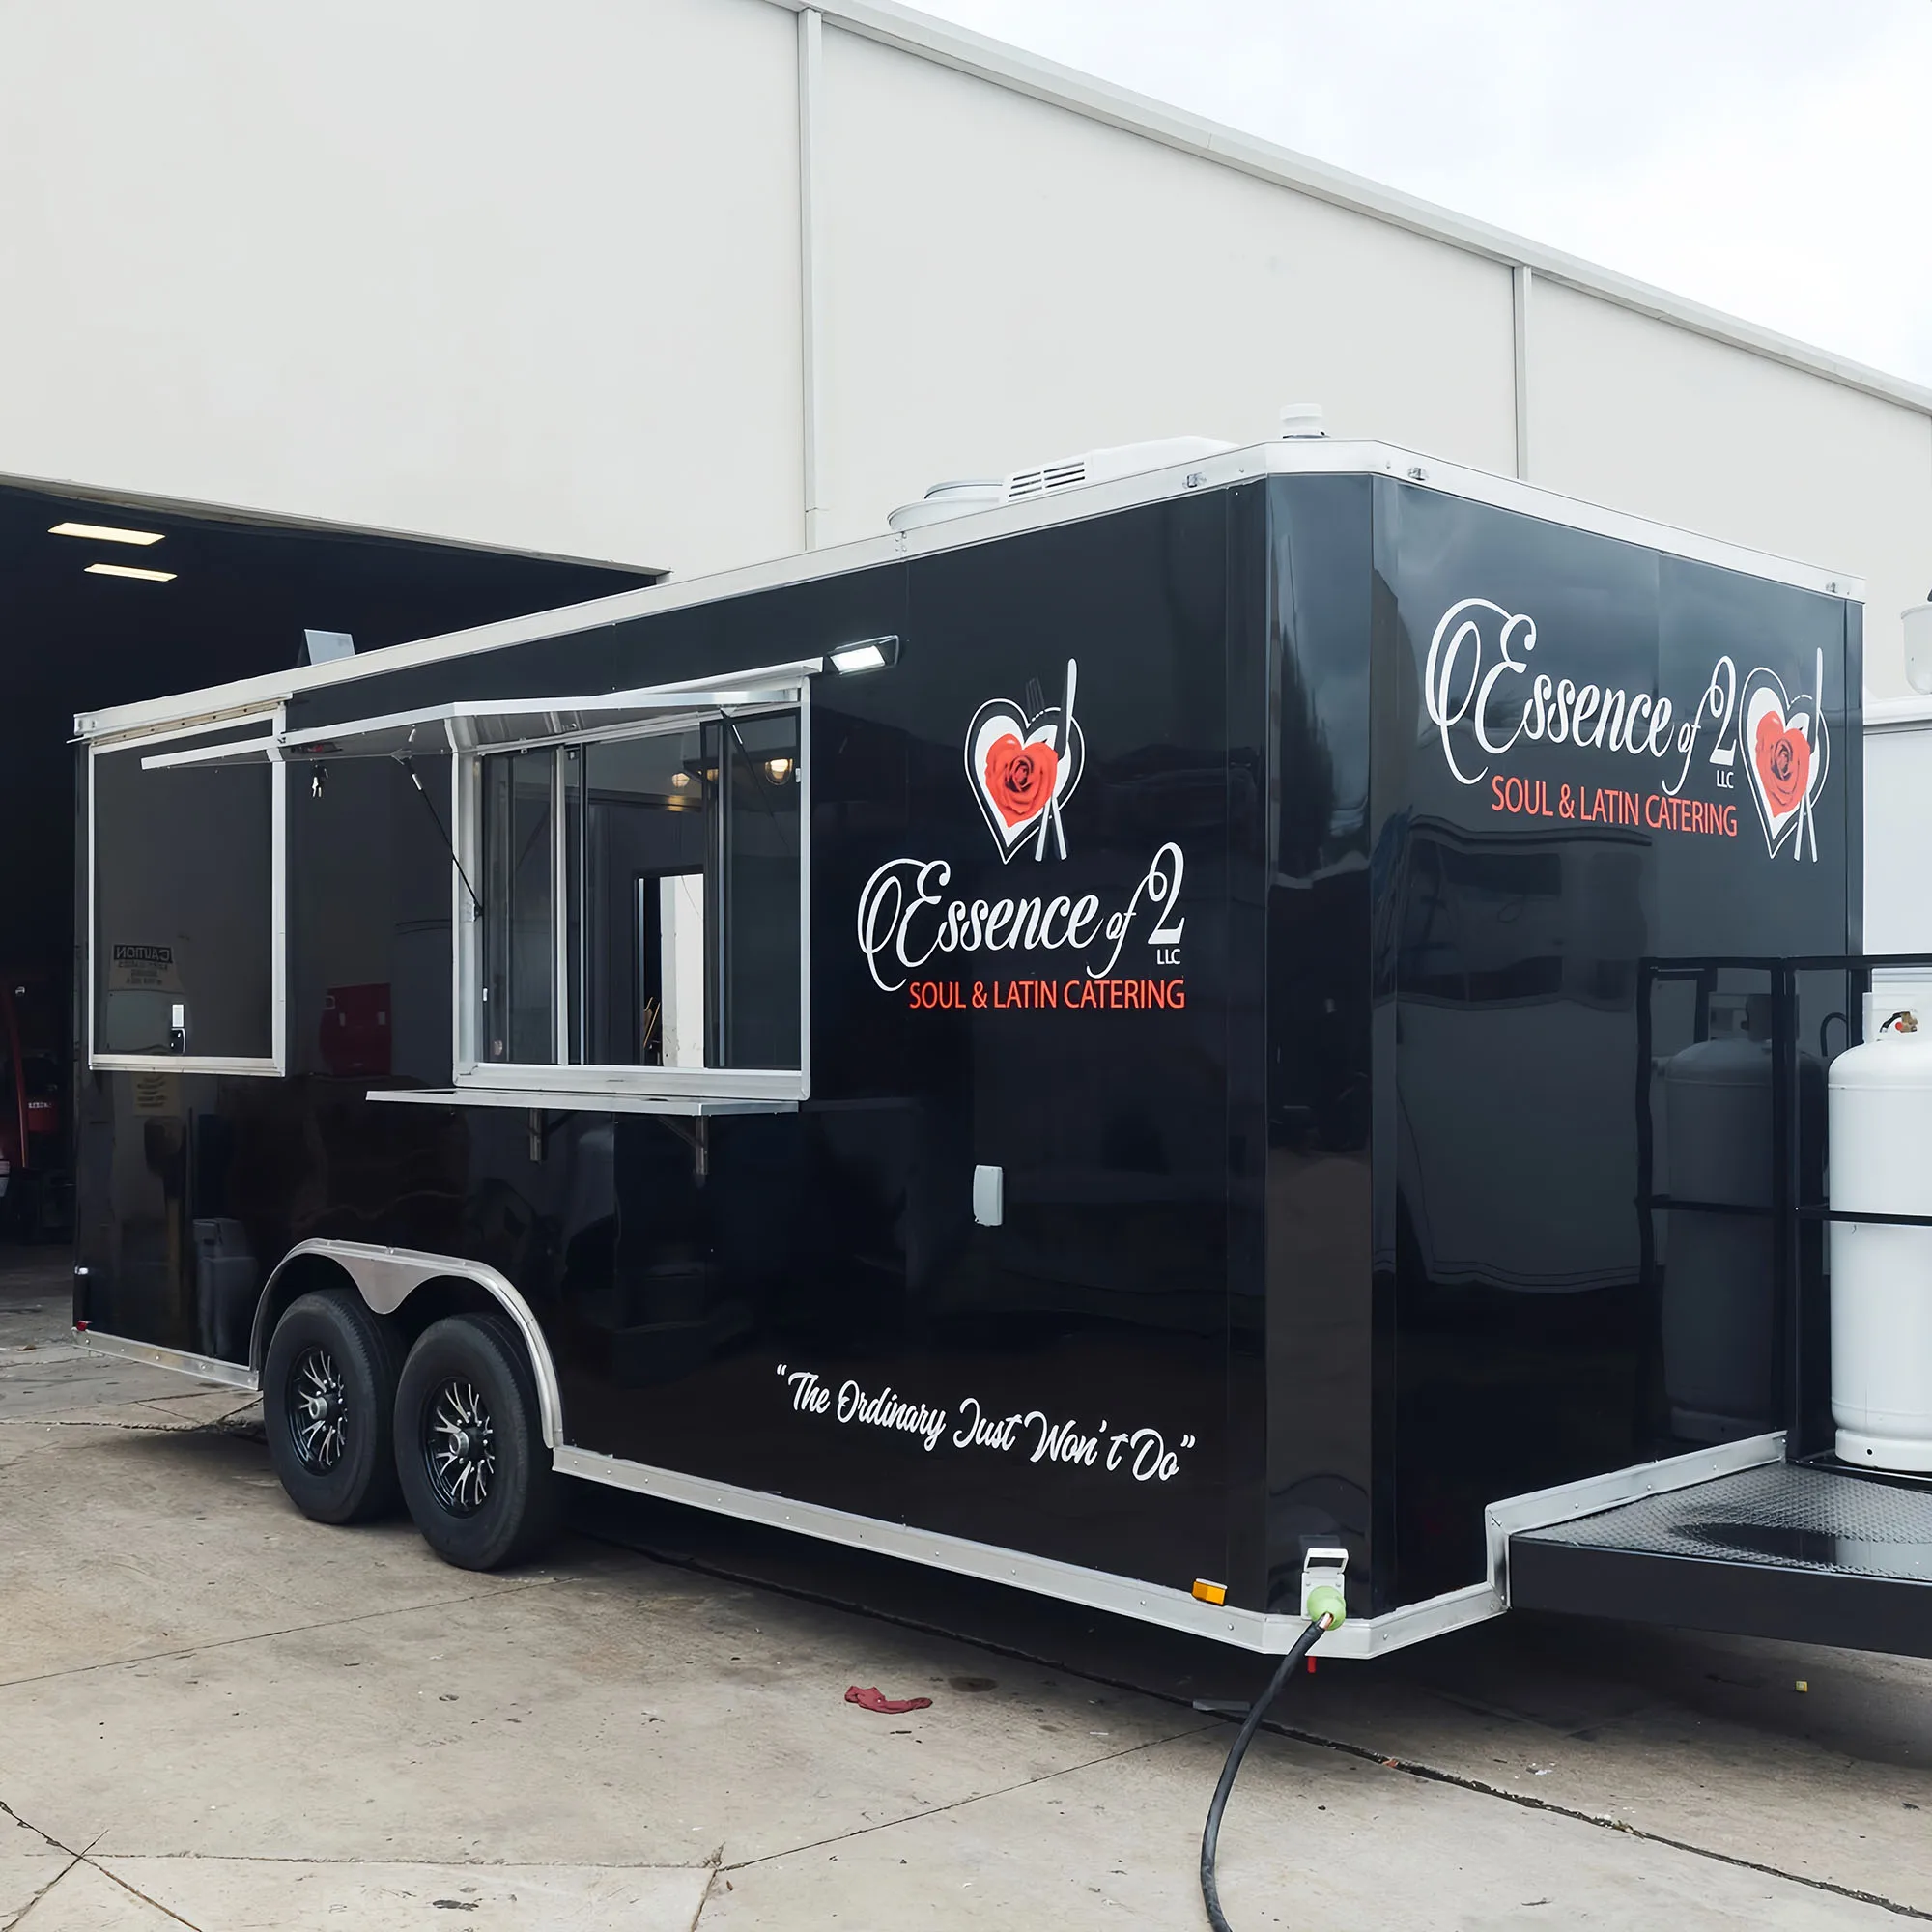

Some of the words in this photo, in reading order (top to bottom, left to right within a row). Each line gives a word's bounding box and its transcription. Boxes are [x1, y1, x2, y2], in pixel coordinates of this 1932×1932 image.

[1425, 597, 1675, 785] Essence
[1662, 684, 1723, 796] of
[1708, 655, 1737, 766] 2
[1491, 775, 1554, 817] SOUL
[1558, 783, 1575, 819] &
[1580, 786, 1640, 826] LATIN
[1645, 794, 1738, 838] CATERING
[1716, 769, 1735, 789] LLC
[857, 858, 1104, 992] Essence
[1086, 871, 1168, 980] of
[1147, 841, 1185, 945] 2
[1156, 948, 1181, 965] LLC
[909, 980, 967, 1009] SOUL
[971, 980, 988, 1009] &
[993, 980, 1058, 1009] LATIN
[1063, 979, 1186, 1009] CATERING
[837, 1379, 947, 1452] Ordinary
[952, 1398, 1023, 1451] Just
